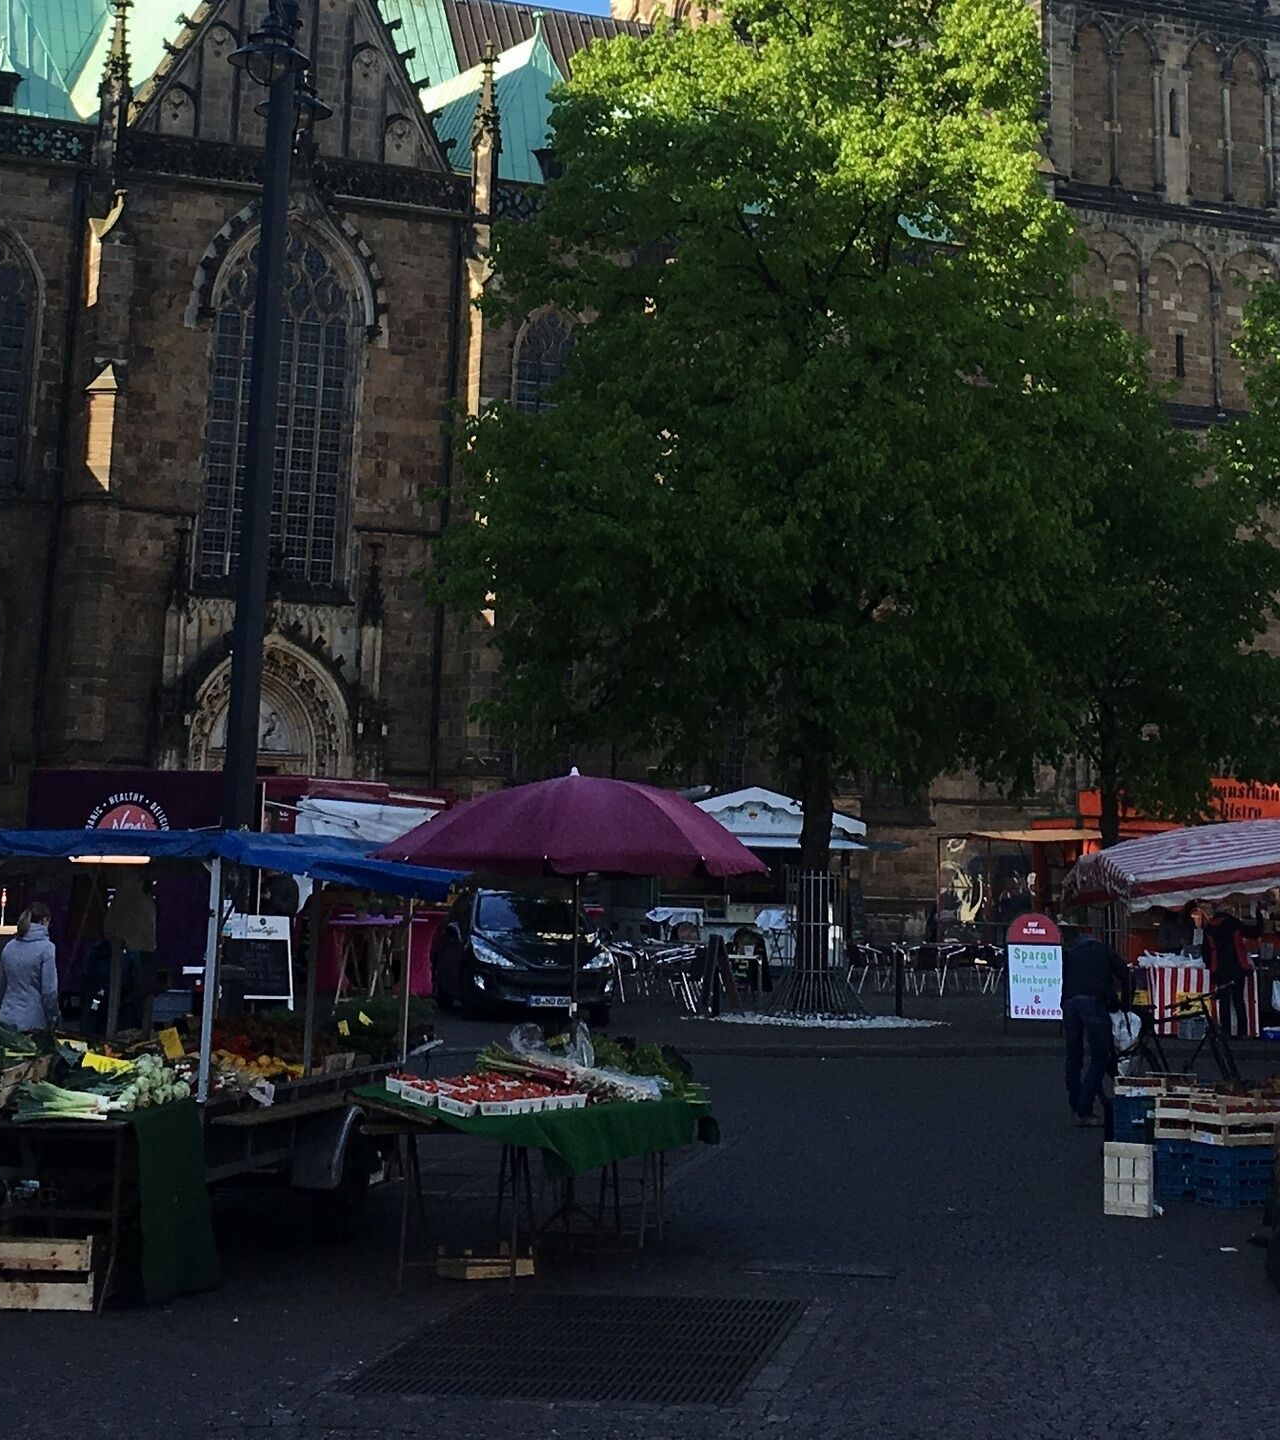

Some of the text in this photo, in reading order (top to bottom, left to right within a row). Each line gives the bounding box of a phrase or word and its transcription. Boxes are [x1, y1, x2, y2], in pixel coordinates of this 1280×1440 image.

[108, 792, 145, 805] HEALTHY
[149, 801, 170, 832] DELICIO
[1013, 947, 1057, 964] Spargel
[1033, 994, 1042, 1004] &
